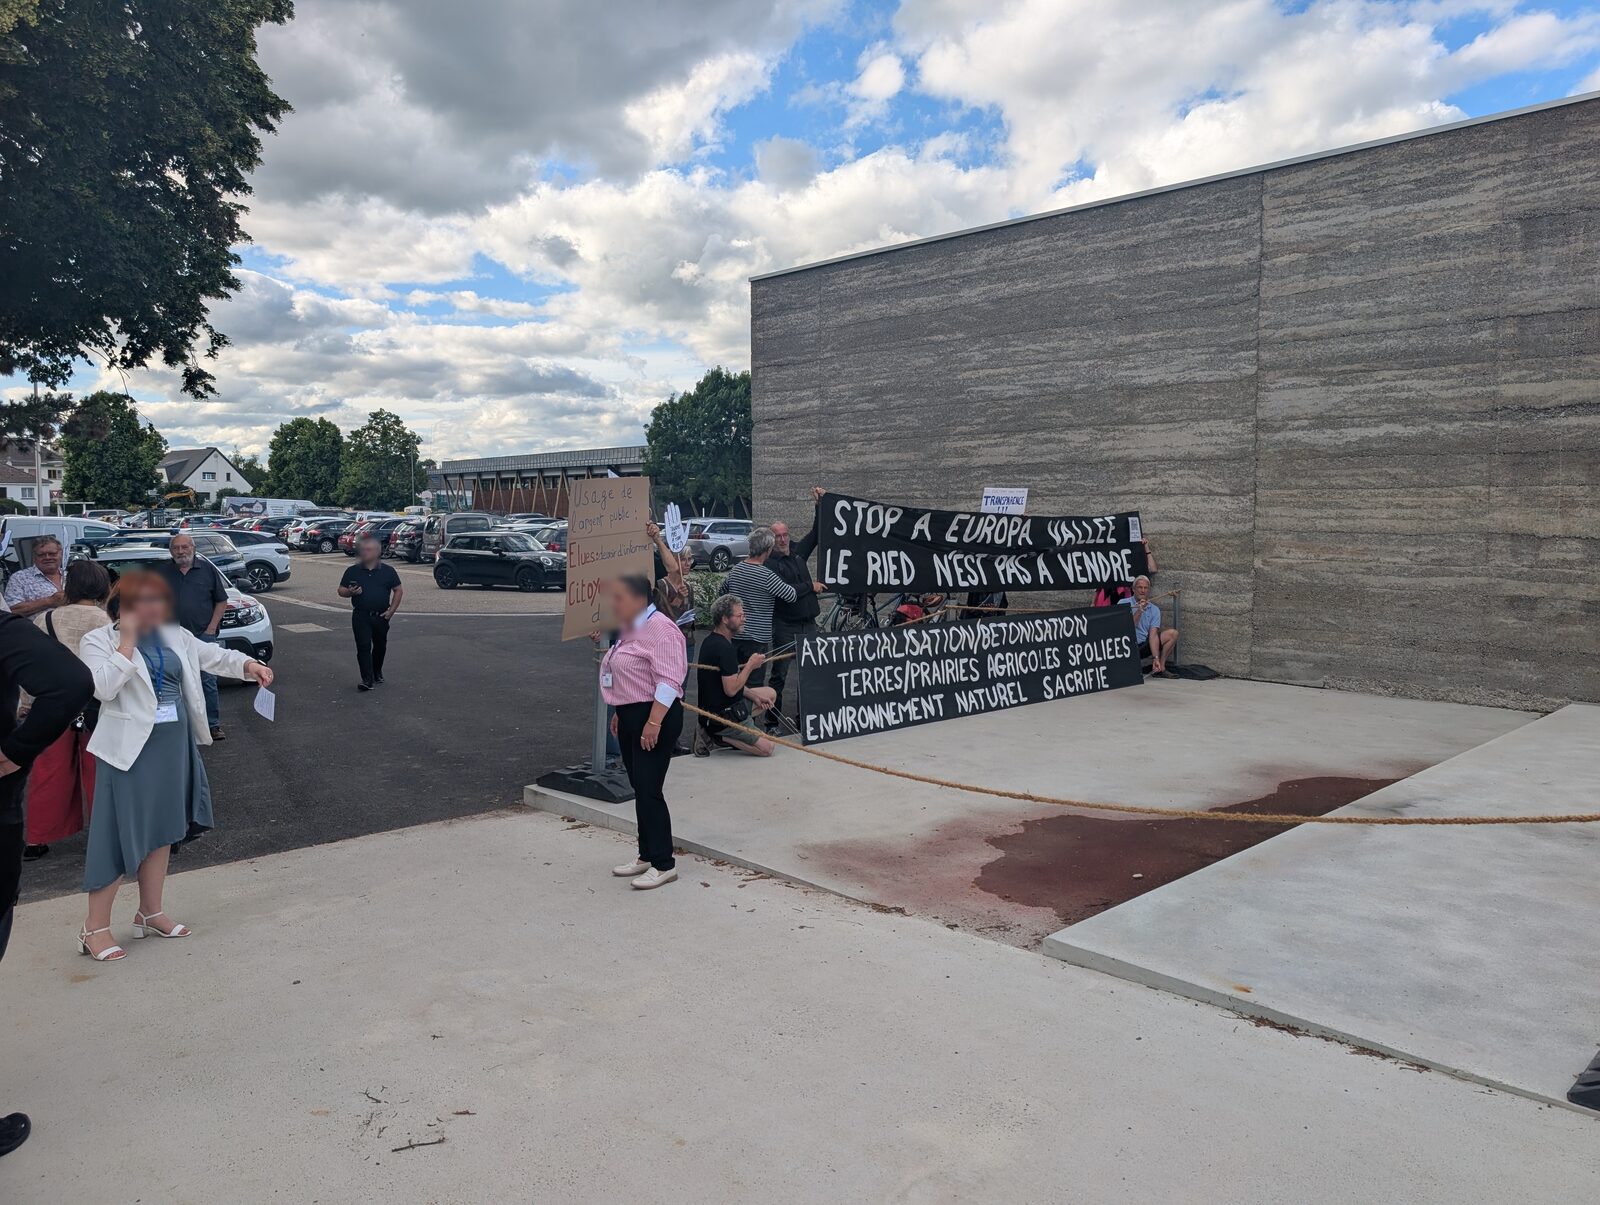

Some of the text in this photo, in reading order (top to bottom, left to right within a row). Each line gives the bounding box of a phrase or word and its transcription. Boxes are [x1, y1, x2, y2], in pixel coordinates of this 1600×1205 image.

[575, 483, 632, 510] Usage de
[984, 495, 1025, 506] TRANSPARENCE
[833, 499, 1116, 547] STOP A EUROPA VALLEE
[825, 548, 1136, 586] LE RIED N'EST PAS A VENDRE
[837, 635, 1131, 699] TERRES/PRAIRIES AGRICOLES SPOLIEES
[805, 666, 1109, 741] ENVIRONNEMENT NATUREL SACRIFIE
